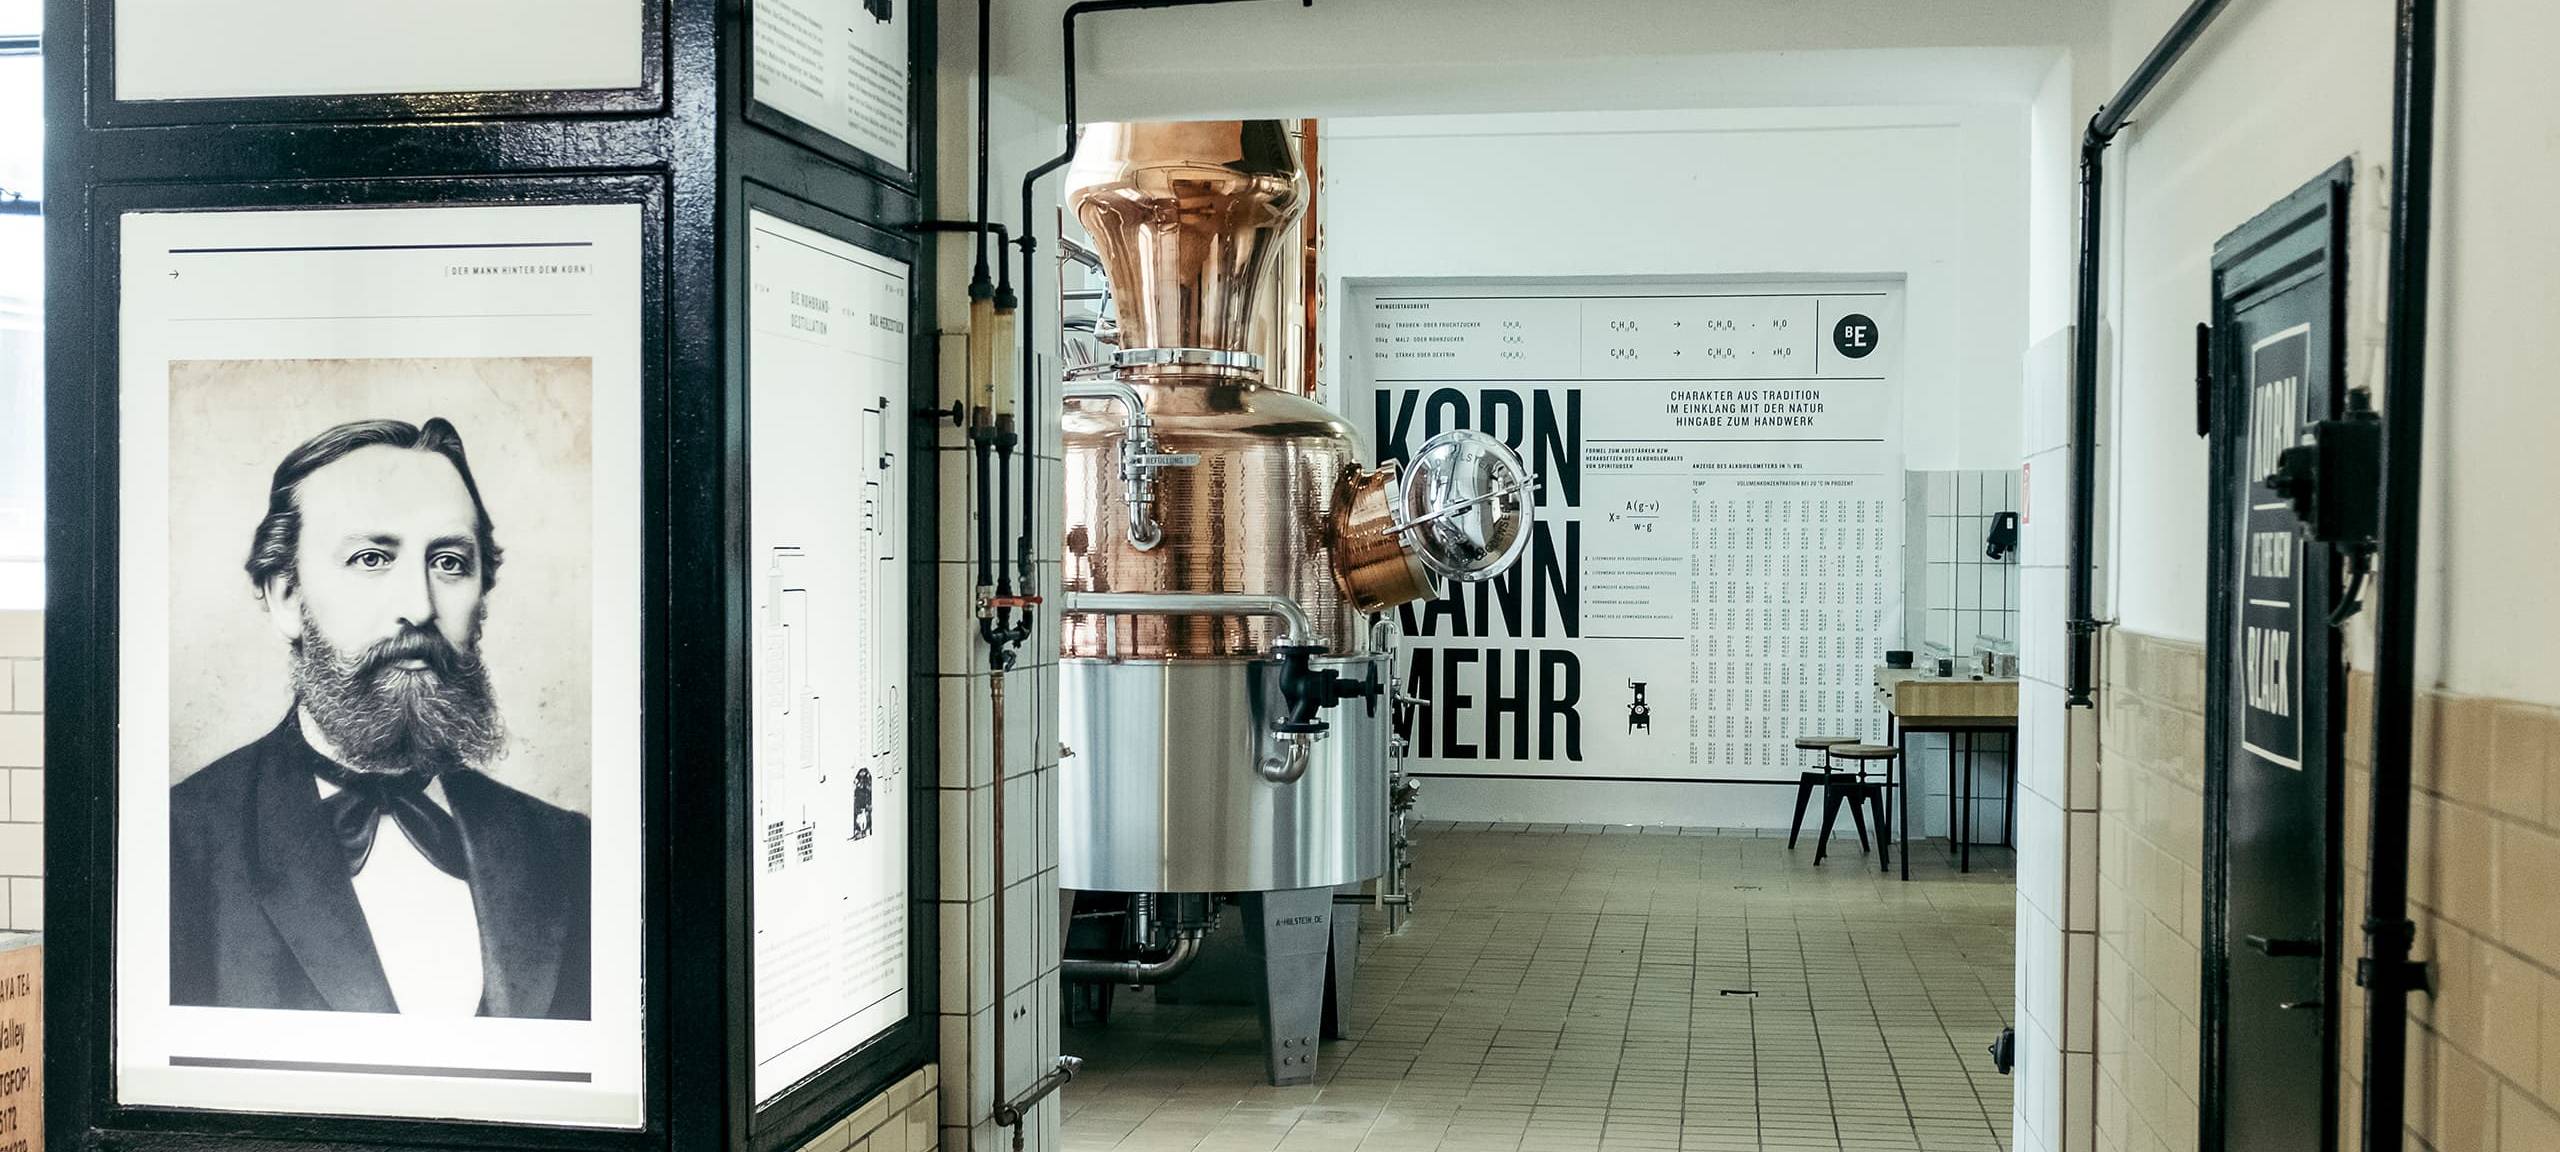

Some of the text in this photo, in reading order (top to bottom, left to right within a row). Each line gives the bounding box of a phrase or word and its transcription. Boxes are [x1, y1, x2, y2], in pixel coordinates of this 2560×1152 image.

[451, 265, 586, 276] DER MANN HINTER DEM KORN
[1670, 390, 1820, 401] CHARAKTER AUS TRADITION
[1666, 403, 1824, 414] IM EINKLANG MIT DER NATUR
[1676, 416, 1814, 427] HINGABE ZUM HANDWERK
[2254, 376, 2298, 482] KORN
[1394, 520, 1580, 638] ANN
[2247, 626, 2291, 717] BLACK
[17, 972, 31, 997] TEA
